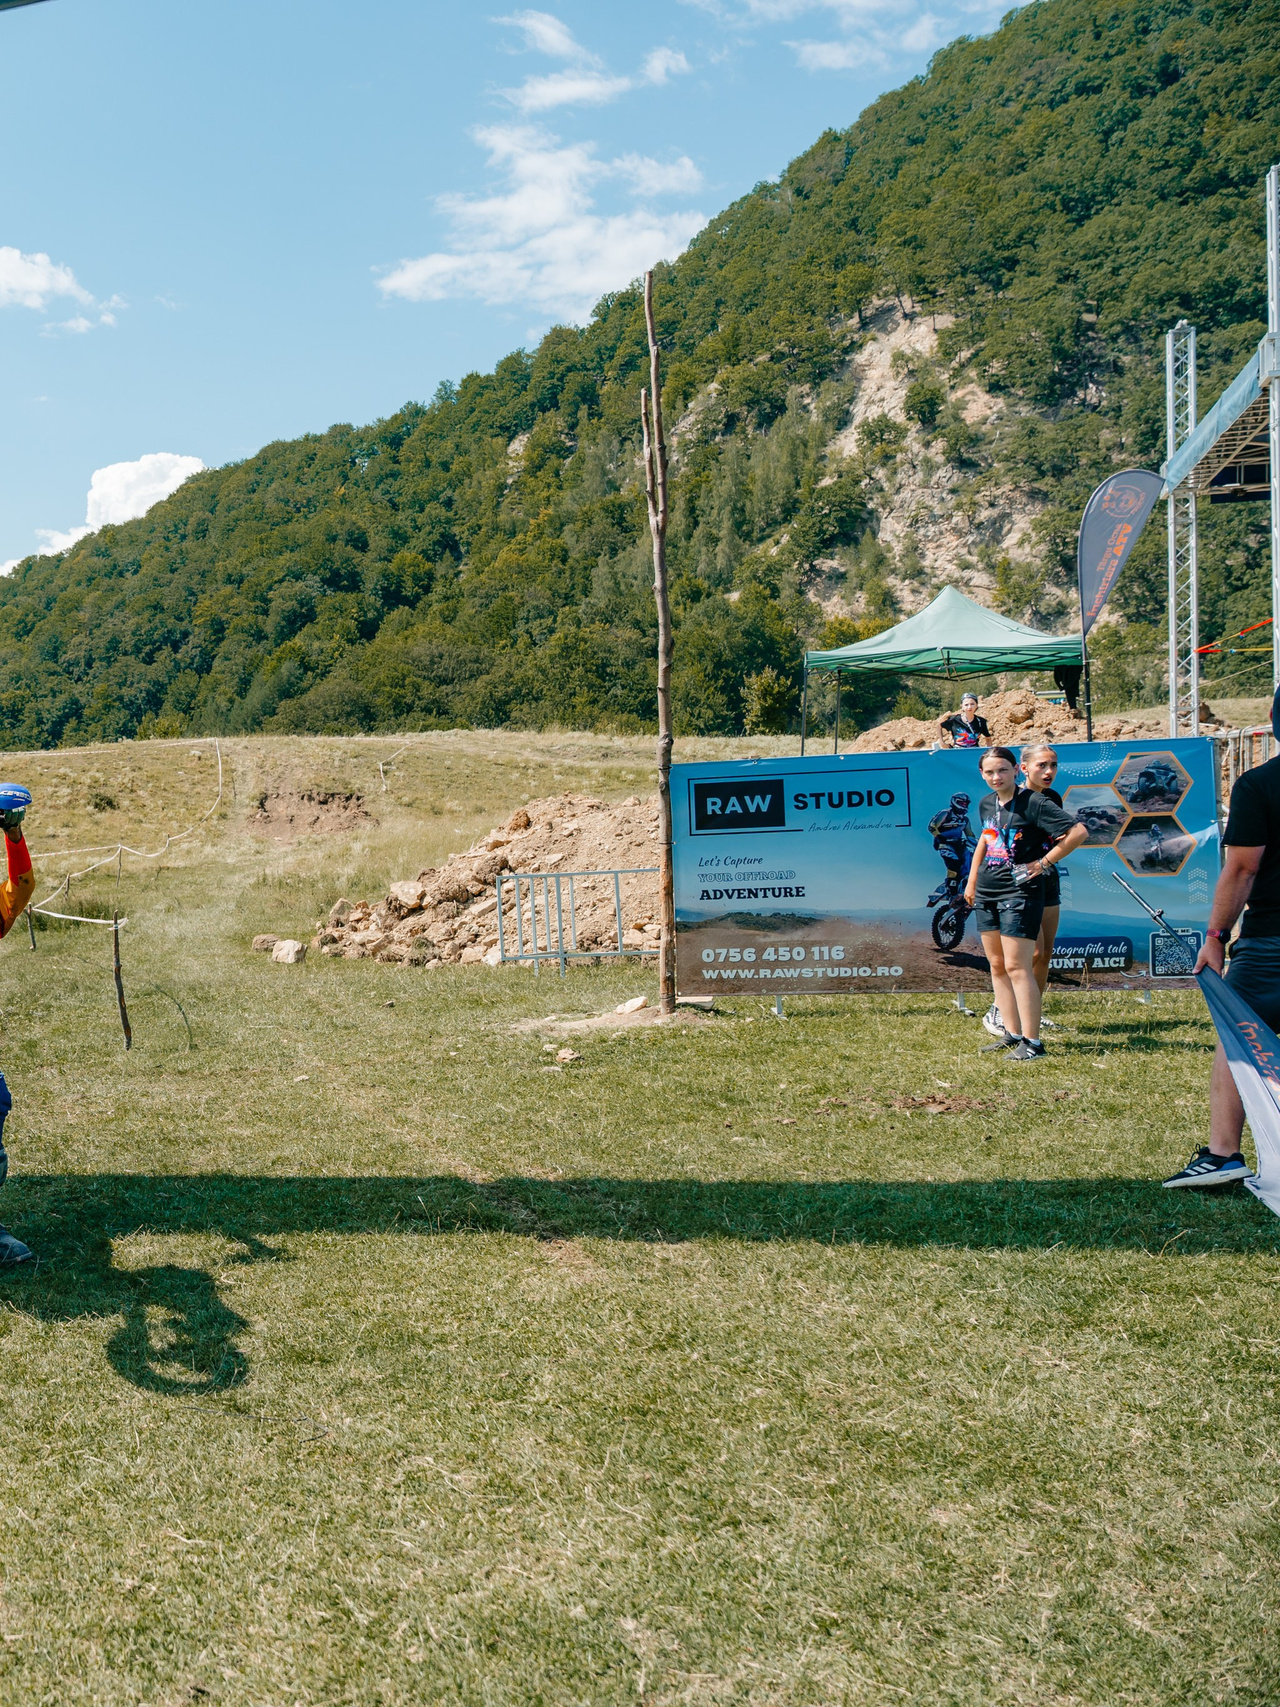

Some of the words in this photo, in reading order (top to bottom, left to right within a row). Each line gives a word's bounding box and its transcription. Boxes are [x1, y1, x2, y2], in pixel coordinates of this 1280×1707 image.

[1112, 522, 1132, 557] ATV
[706, 794, 772, 815] RAW
[793, 789, 895, 811] STUDIO
[698, 855, 721, 868] Let's
[723, 855, 763, 869] Capture
[697, 873, 733, 883] YOUR
[734, 870, 796, 882] OFFROAD
[699, 886, 806, 901] ADVENTURE
[701, 947, 757, 963] 0756
[761, 946, 806, 962] 450
[811, 945, 846, 961] 116
[1052, 942, 1104, 959] otografiile
[1107, 941, 1128, 954] tale
[1092, 956, 1125, 968] AICI
[701, 966, 904, 979] WWW.RAWSTUDIO.RO
